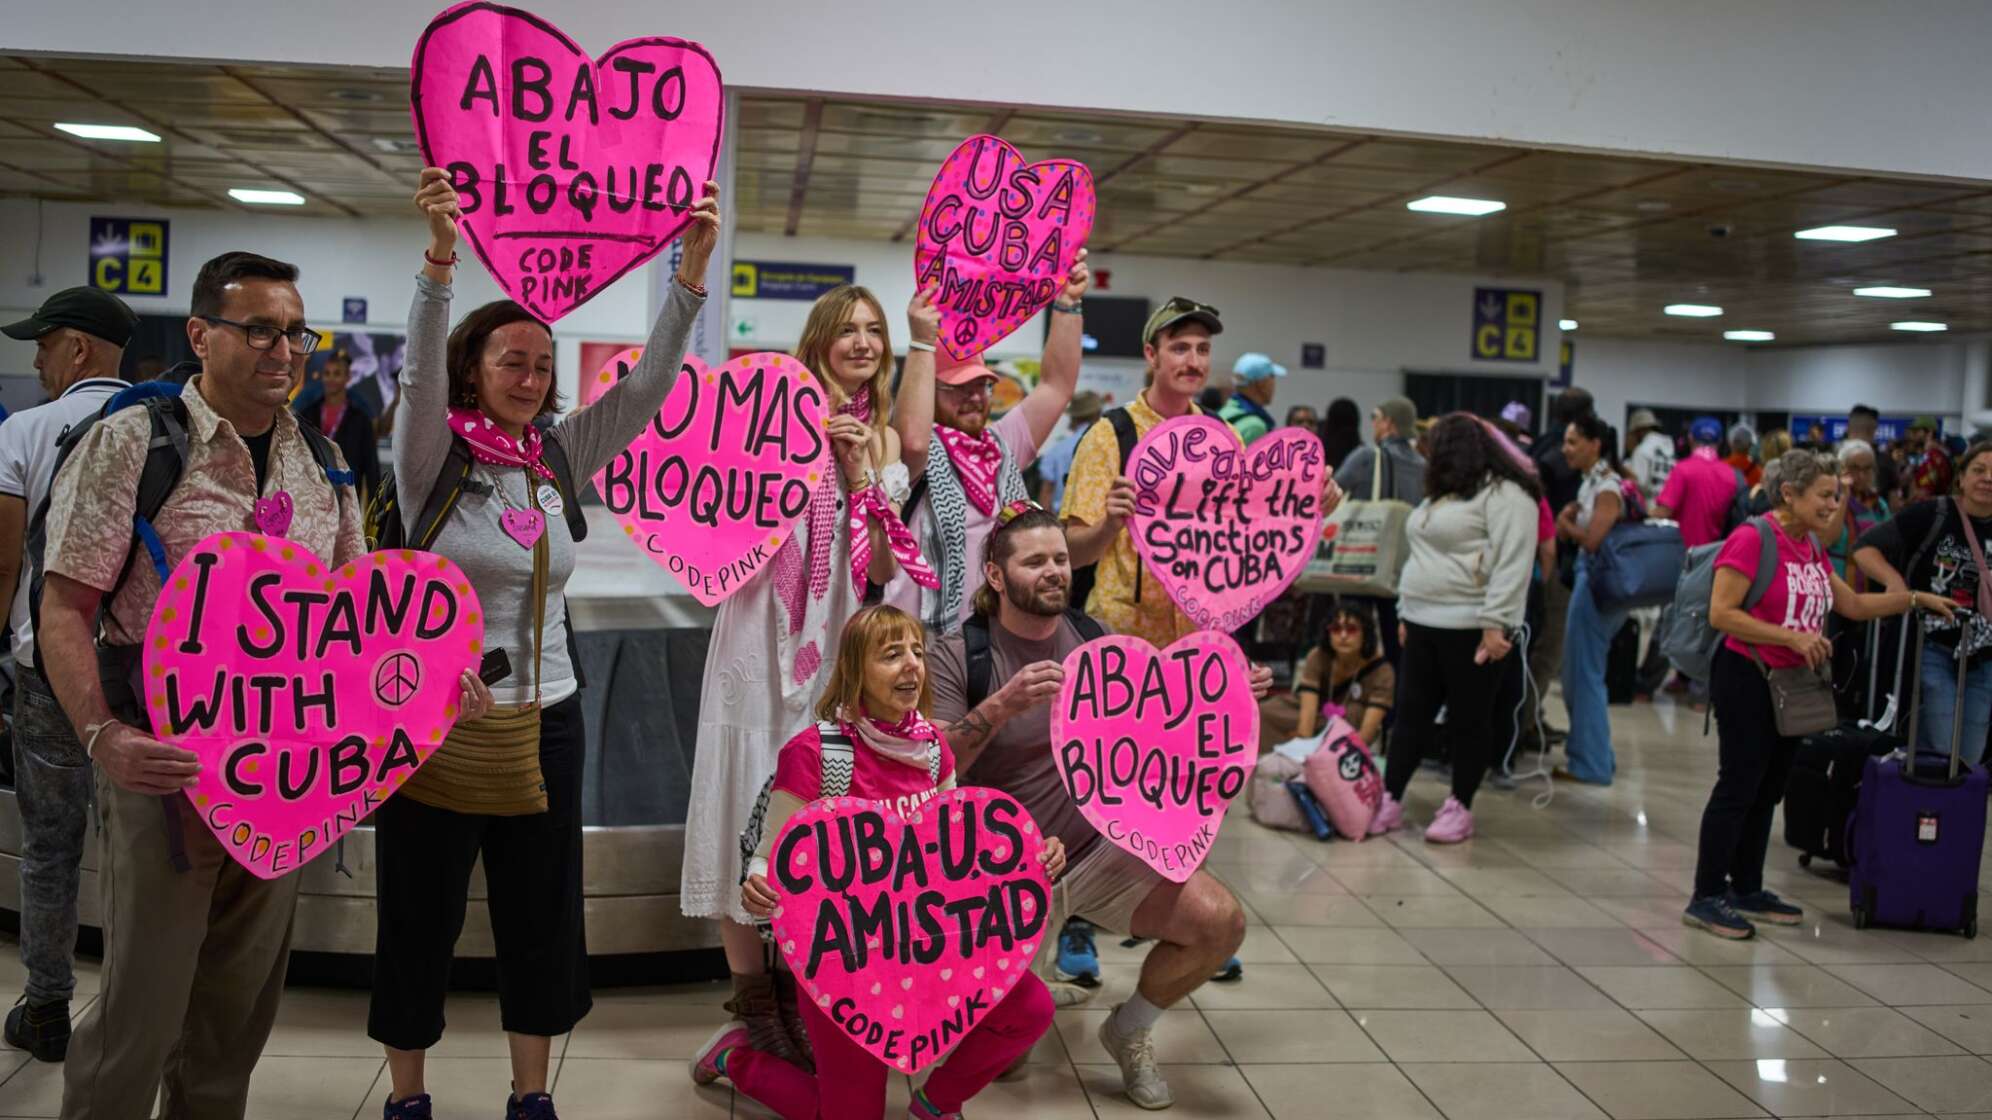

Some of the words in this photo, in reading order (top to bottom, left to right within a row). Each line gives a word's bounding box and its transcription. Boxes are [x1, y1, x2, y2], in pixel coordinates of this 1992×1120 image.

[460, 54, 686, 125] ABAJO
[528, 131, 578, 170] EL
[966, 139, 1074, 226] USA
[446, 160, 694, 222] BLOQUEO
[519, 244, 593, 273] CODE
[928, 194, 1063, 275] CUBA
[96, 256, 121, 290] C
[137, 264, 152, 285] 4
[520, 275, 593, 304] PINK
[920, 243, 1056, 320] AMISTAD
[1477, 323, 1499, 357] C
[617, 361, 698, 440] O
[711, 368, 822, 464] MAS
[605, 449, 810, 528] BLOQUEO
[1165, 473, 1251, 525] Lift
[1265, 479, 1315, 519] the
[646, 534, 769, 597] CODEPINK
[1145, 520, 1304, 564] Sanctions
[1172, 561, 1199, 580] on
[1204, 552, 1283, 593] CUBA
[179, 552, 218, 654] I
[236, 568, 457, 661] STAND
[166, 671, 336, 735] WITH
[1070, 645, 1228, 730] ABAJO
[225, 728, 420, 800] CUBA
[1198, 714, 1244, 758] EL
[1062, 737, 1245, 816] BLOQUEO
[209, 789, 382, 873] CODEPINK
[776, 798, 1027, 895] CUBA-U.S.
[1108, 820, 1215, 871] CODEPINK
[804, 879, 1048, 980] AMISTAD
